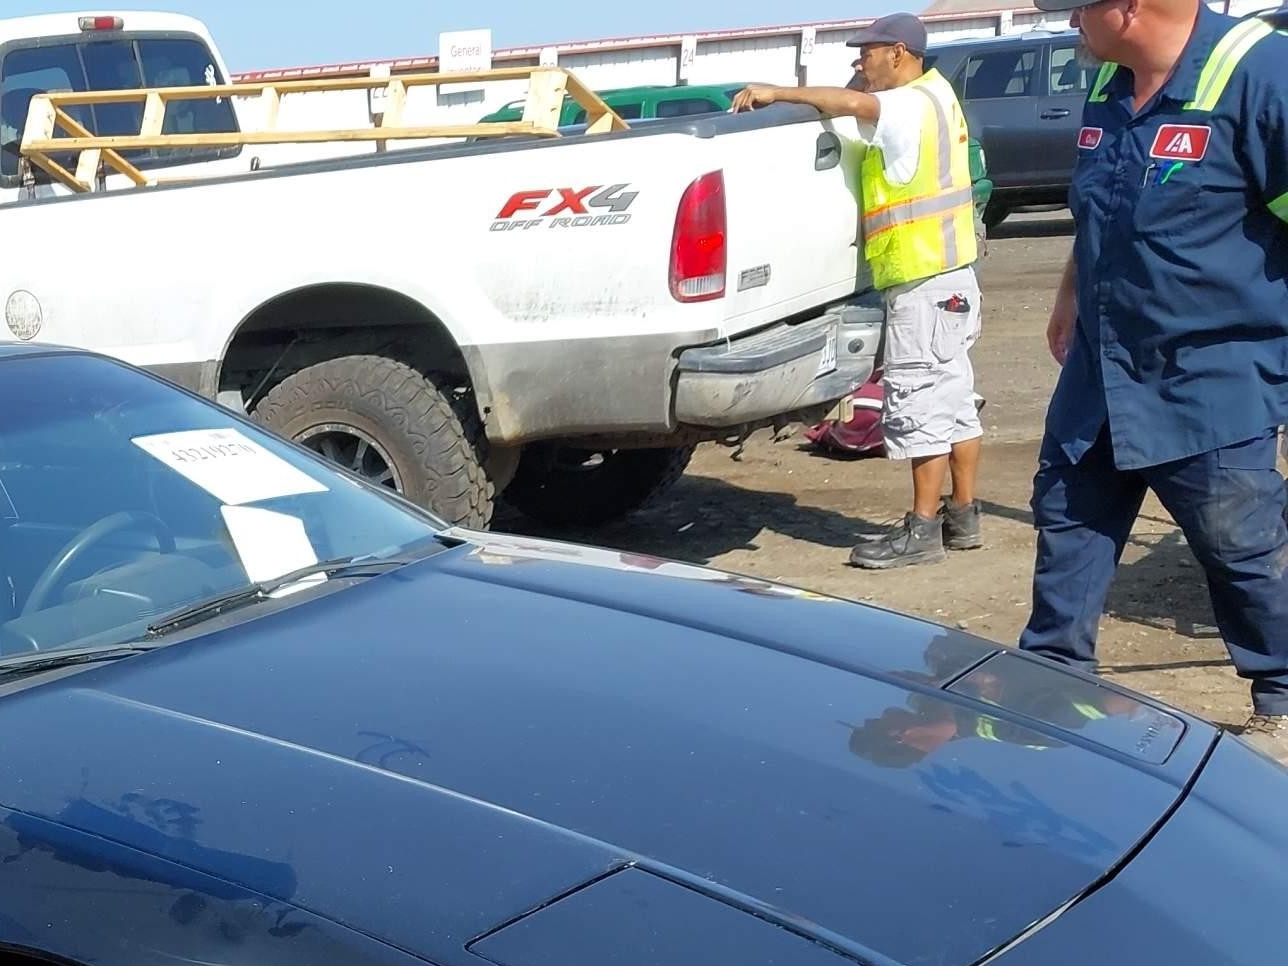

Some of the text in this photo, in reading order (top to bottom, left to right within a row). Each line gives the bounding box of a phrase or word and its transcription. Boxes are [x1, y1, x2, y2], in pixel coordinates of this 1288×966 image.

[451, 45, 481, 57] General
[803, 38, 814, 54] 25
[682, 49, 694, 67] 24
[495, 183, 640, 219] FX4
[489, 213, 632, 232] OFF ROAD
